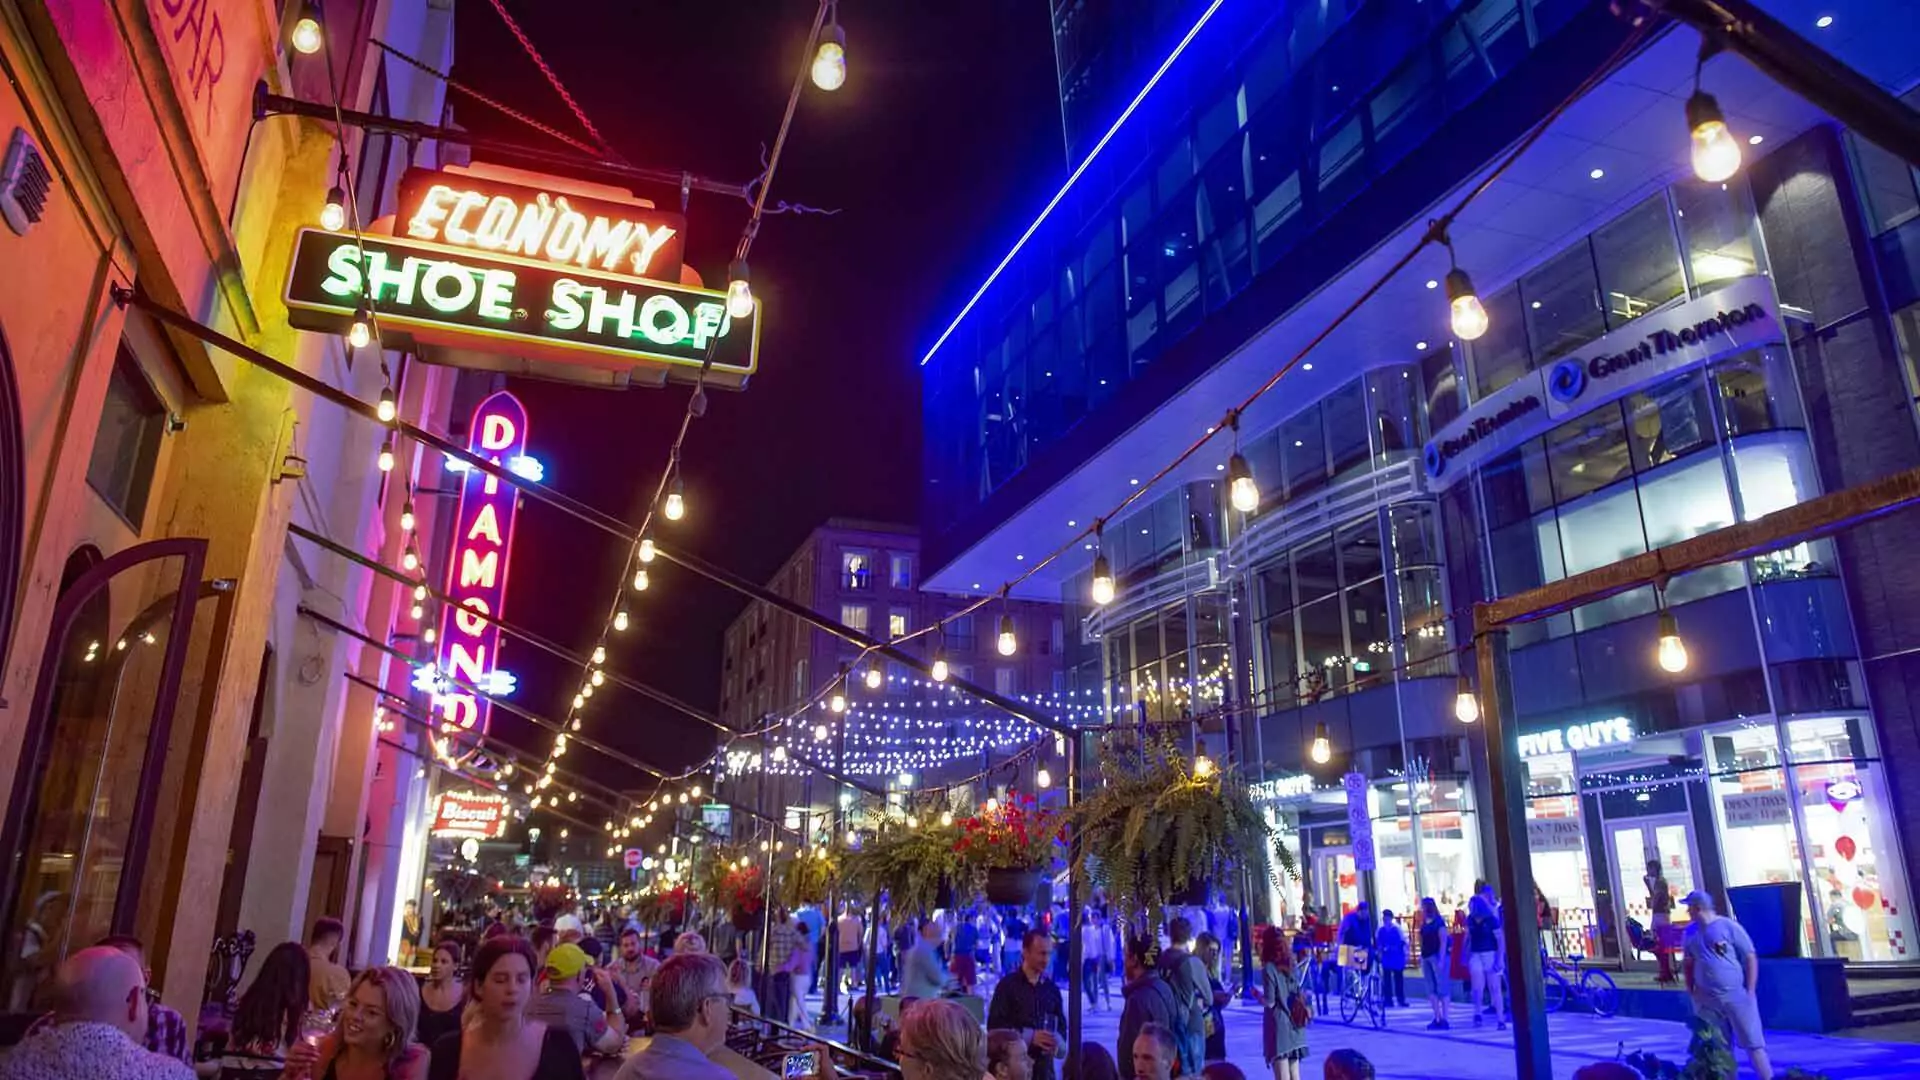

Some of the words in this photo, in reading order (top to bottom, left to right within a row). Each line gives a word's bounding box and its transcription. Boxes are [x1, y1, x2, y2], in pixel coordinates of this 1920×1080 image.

[408, 184, 677, 275] ECONOMY
[321, 244, 517, 321] SHOE
[549, 278, 731, 349] SHOP
[1588, 341, 1652, 378] Grant
[1647, 303, 1766, 355] Thornton
[440, 413, 516, 732] DIAMOND
[1517, 729, 1564, 757] FIVE
[1567, 716, 1634, 750] GUYS
[1554, 821, 1580, 833] DAYS
